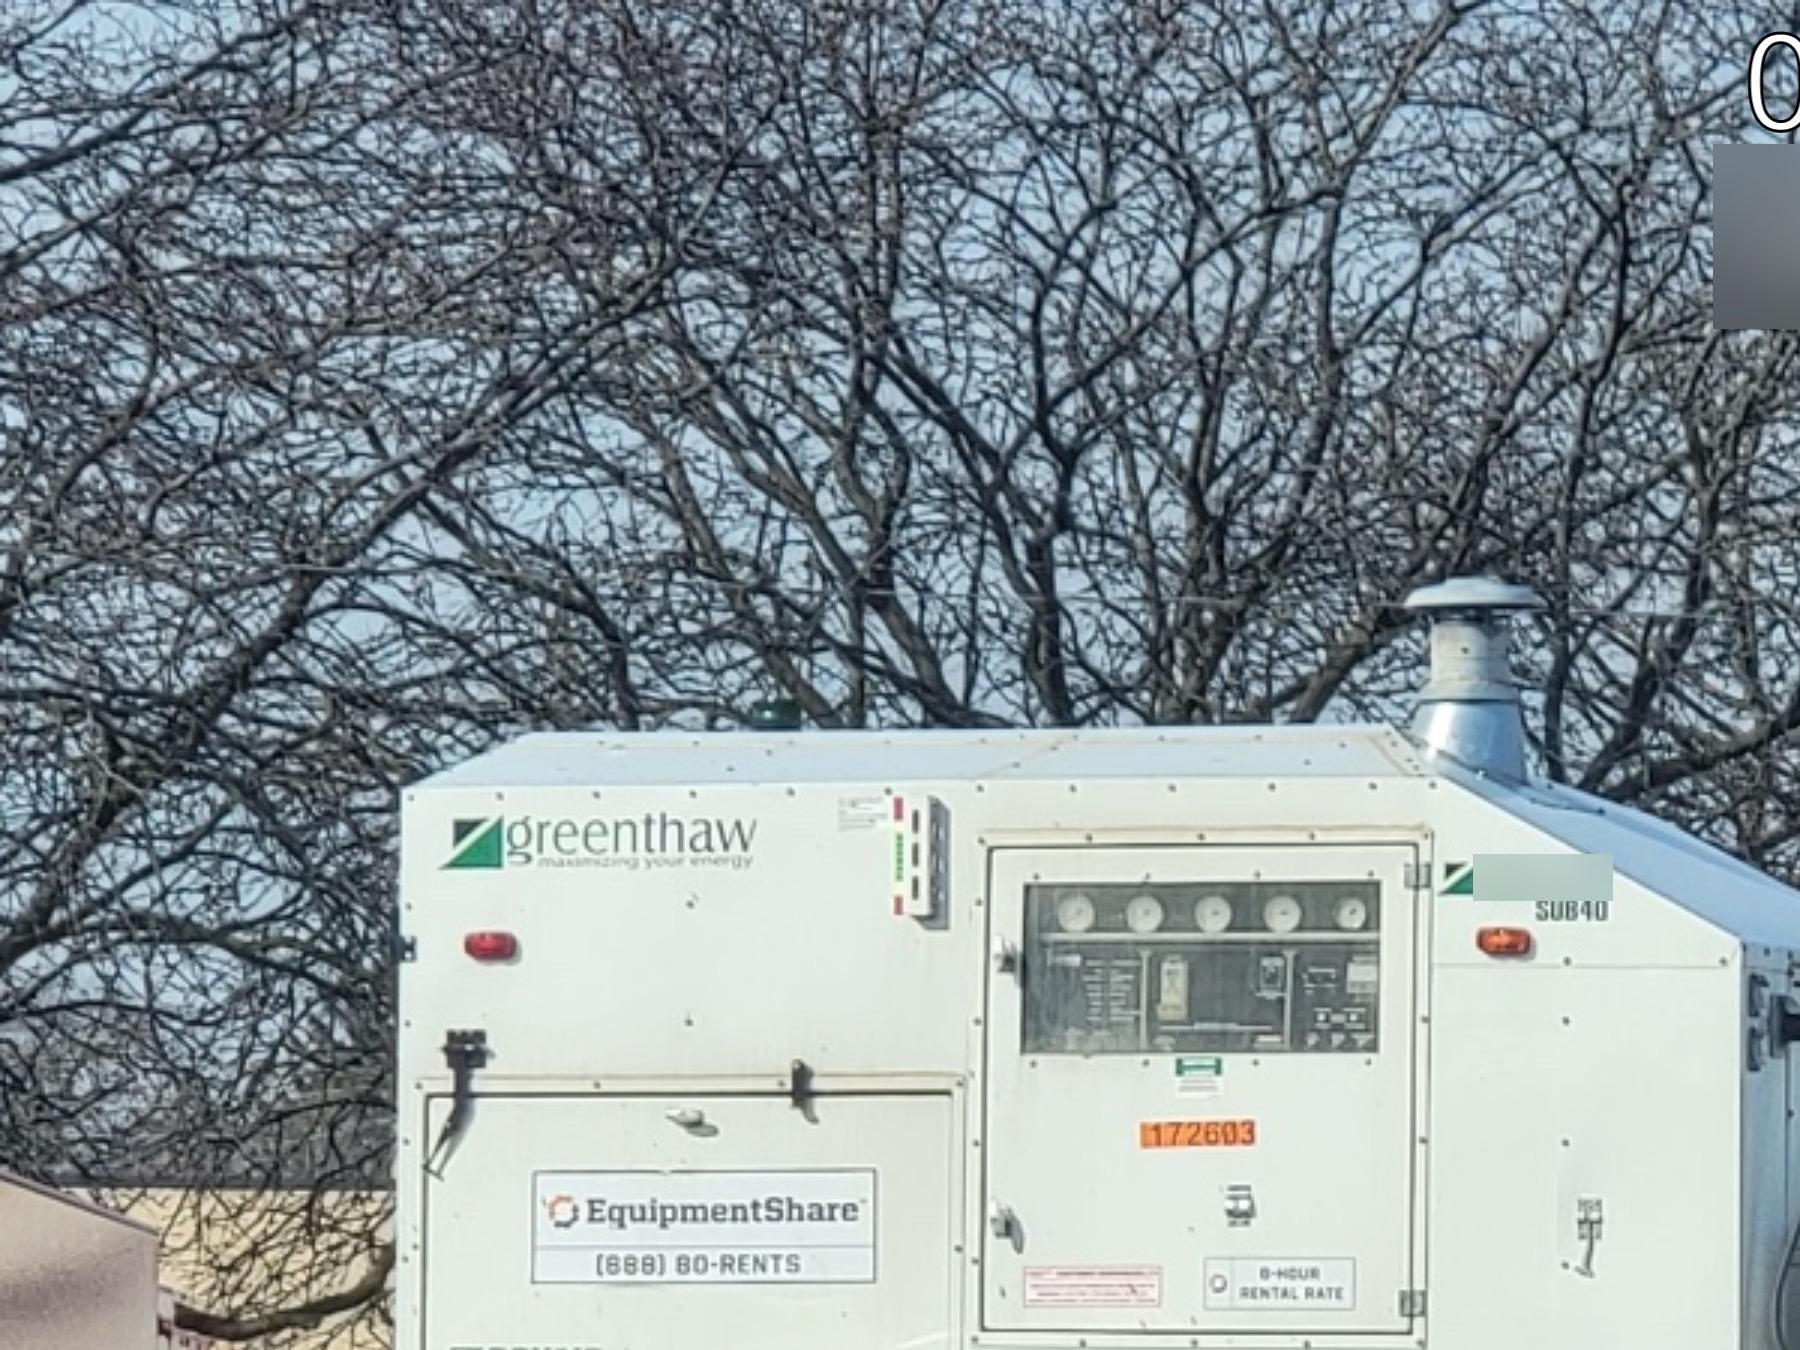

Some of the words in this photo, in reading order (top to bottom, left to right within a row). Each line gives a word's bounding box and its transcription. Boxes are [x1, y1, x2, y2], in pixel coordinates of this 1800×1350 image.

[506, 812, 757, 866] greenthaw
[537, 855, 640, 871] maximizing
[645, 856, 686, 870] your
[690, 856, 754, 871] energy
[1535, 899, 1609, 922] SUB40
[1150, 1119, 1256, 1147] 172603
[587, 1197, 859, 1230] EquipmentShare
[676, 1253, 802, 1275] 80-RENTS
[1239, 1286, 1299, 1301] RENTAL
[1304, 1287, 1345, 1301] RATE
